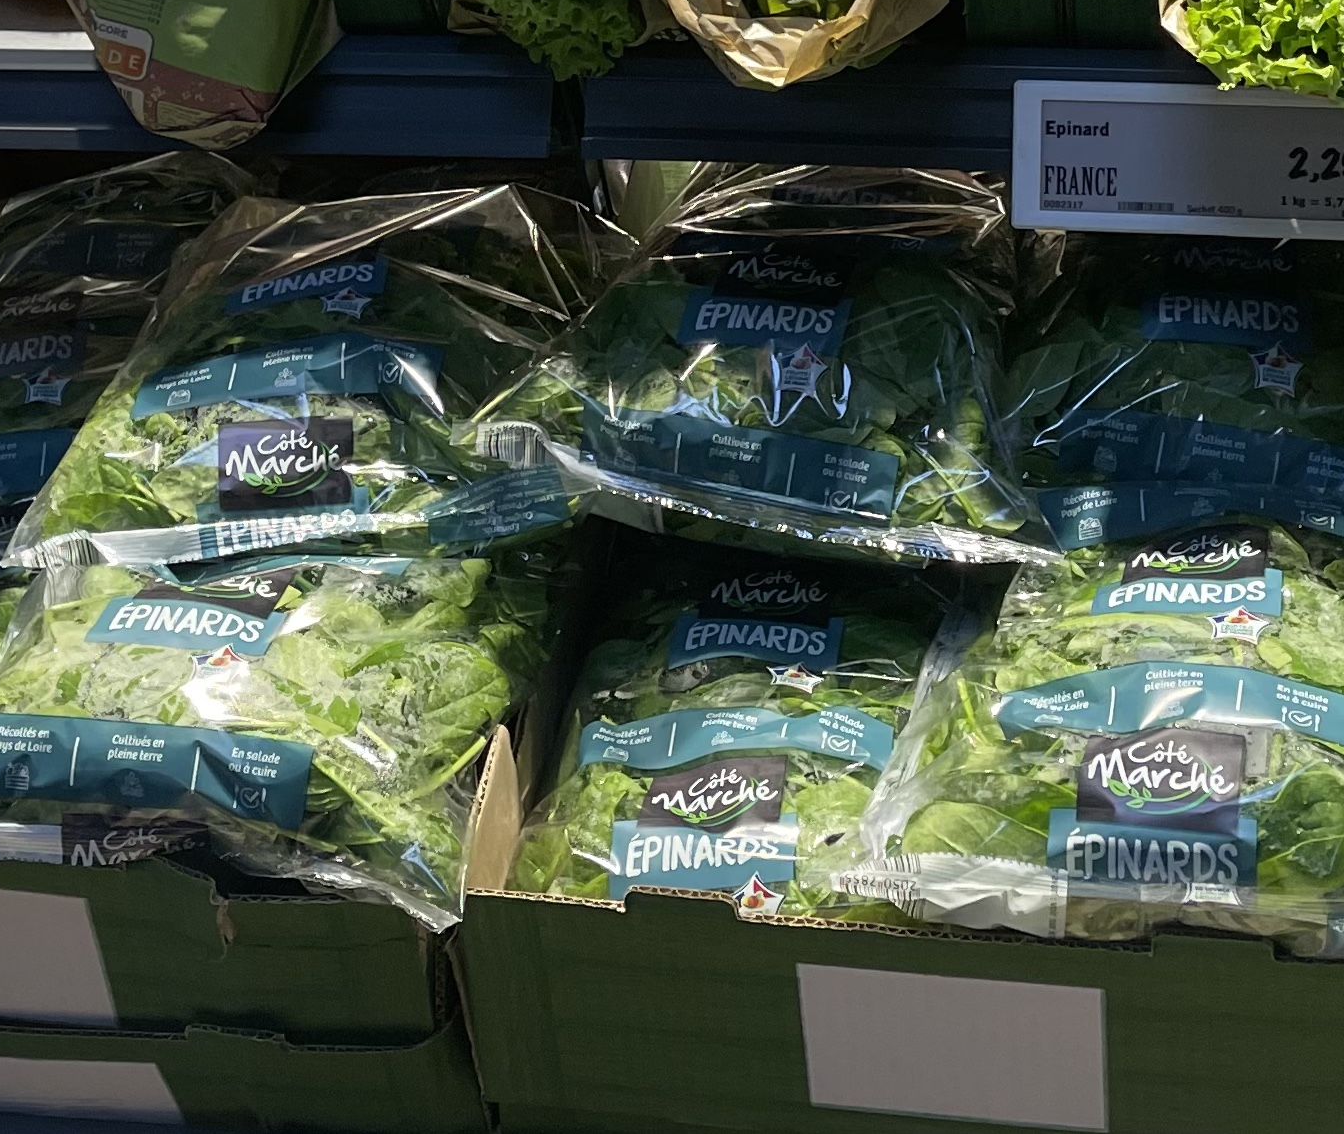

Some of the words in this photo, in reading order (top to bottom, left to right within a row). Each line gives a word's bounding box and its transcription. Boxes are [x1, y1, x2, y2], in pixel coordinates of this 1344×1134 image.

[1045, 121, 1110, 138] Epinard
[1043, 165, 1118, 197] FRANCE
[1292, 196, 1306, 209] kg
[729, 254, 843, 290] Marché
[695, 298, 837, 337] ÉPINARDS
[257, 429, 314, 454] Côté
[225, 444, 347, 482] Marché
[824, 453, 836, 464] En
[836, 456, 870, 472] salade
[843, 471, 869, 485] cuire
[1132, 541, 1262, 569] Marché
[711, 577, 827, 606] Marché
[108, 602, 265, 644] ÉPINARDS
[684, 621, 827, 656] ÉPINARDS
[1145, 669, 1189, 680] Cultivés
[1190, 670, 1205, 680] en
[1144, 679, 1176, 694] pleine
[1290, 687, 1330, 705] salade
[1275, 693, 1289, 702] ou
[1299, 699, 1329, 713] cuire
[833, 712, 866, 731] salade
[37, 729, 50, 739] en
[112, 734, 151, 749] Cultivés
[152, 738, 165, 749] en
[13, 740, 26, 752] de
[27, 740, 53, 754] Loire
[107, 748, 138, 764] pleine
[139, 751, 163, 763] terre
[231, 747, 244, 758] En
[245, 748, 281, 765] salade
[1127, 741, 1194, 767] Côté
[228, 762, 242, 773] ou
[251, 765, 278, 779] cuire
[1088, 752, 1235, 796] Marché
[689, 768, 743, 796] Côté
[651, 778, 779, 814] Marché
[102, 827, 164, 851] Côté
[626, 836, 780, 877] ÉPINARDS
[1066, 827, 1240, 886] ÉPINARDS
[884, 877, 917, 892] 2050
